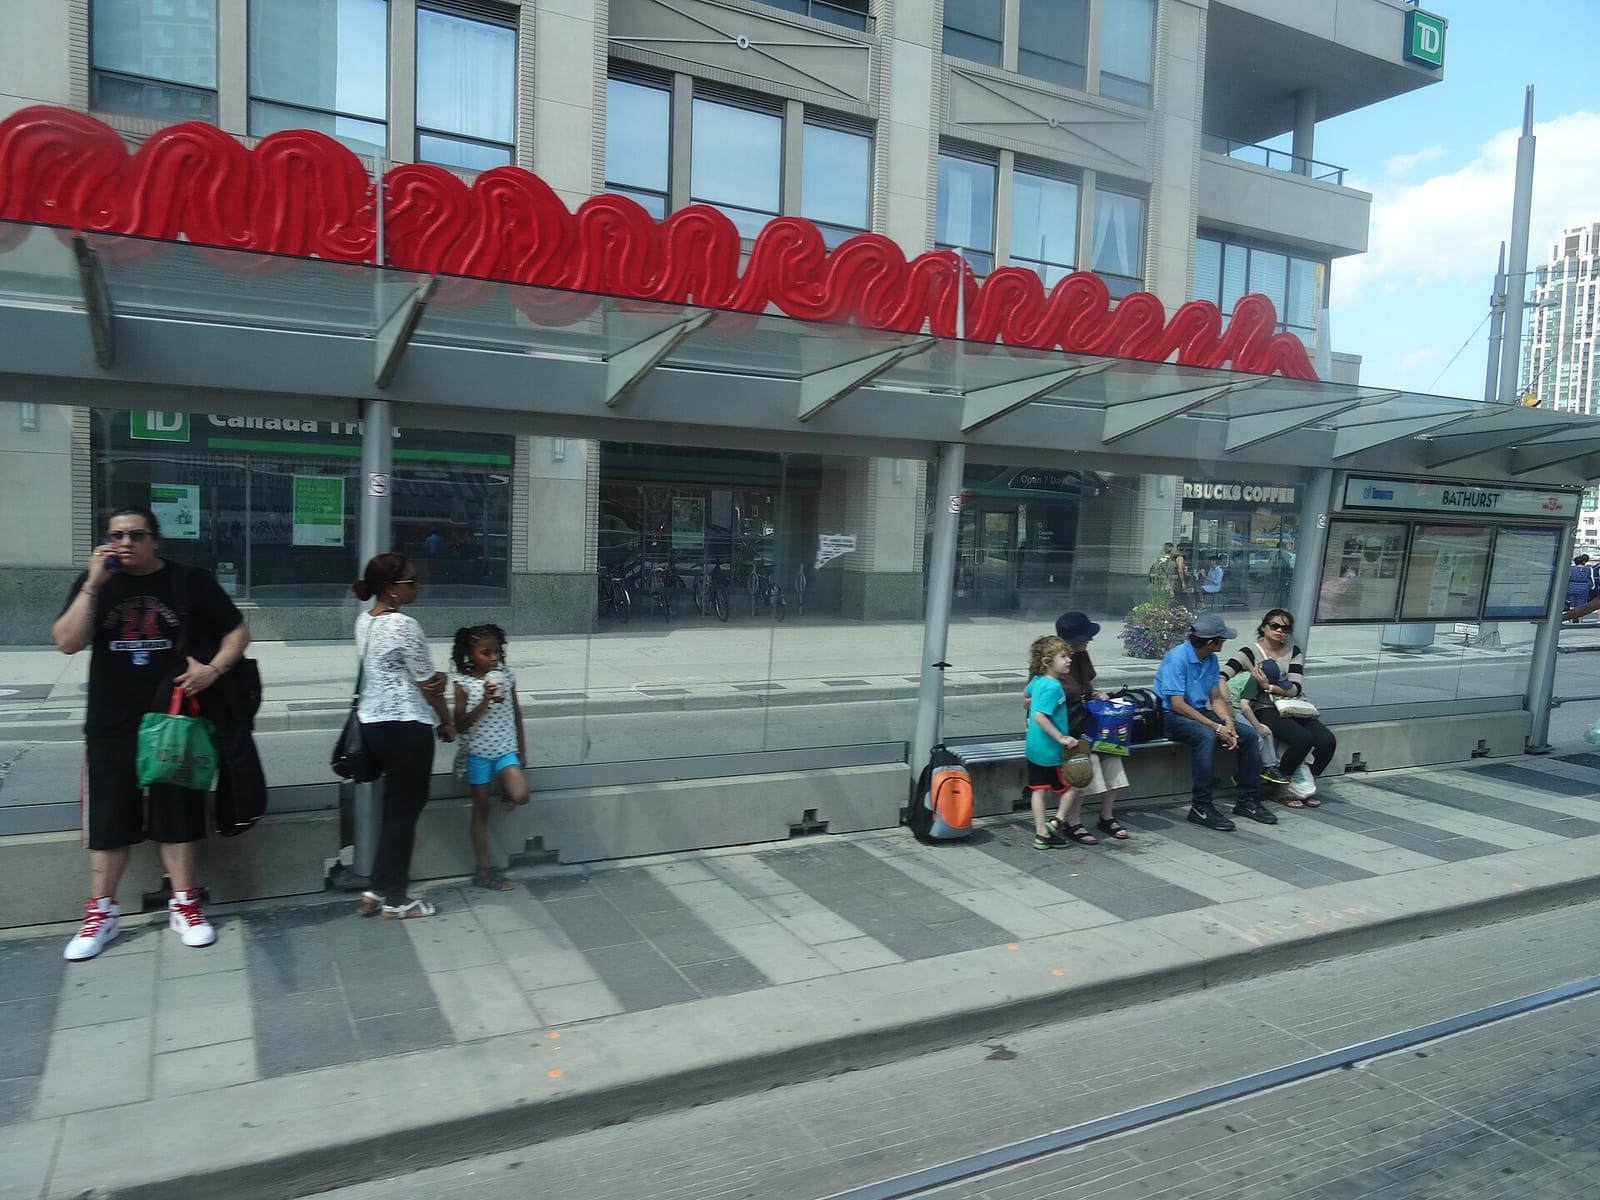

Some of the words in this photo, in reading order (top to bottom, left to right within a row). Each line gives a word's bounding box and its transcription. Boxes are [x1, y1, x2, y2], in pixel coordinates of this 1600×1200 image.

[1417, 21, 1440, 54] TD
[208, 414, 318, 433] Canada
[1021, 474, 1042, 485] Open
[1243, 486, 1295, 503] COFFEE
[1442, 490, 1500, 508] BATHURST
